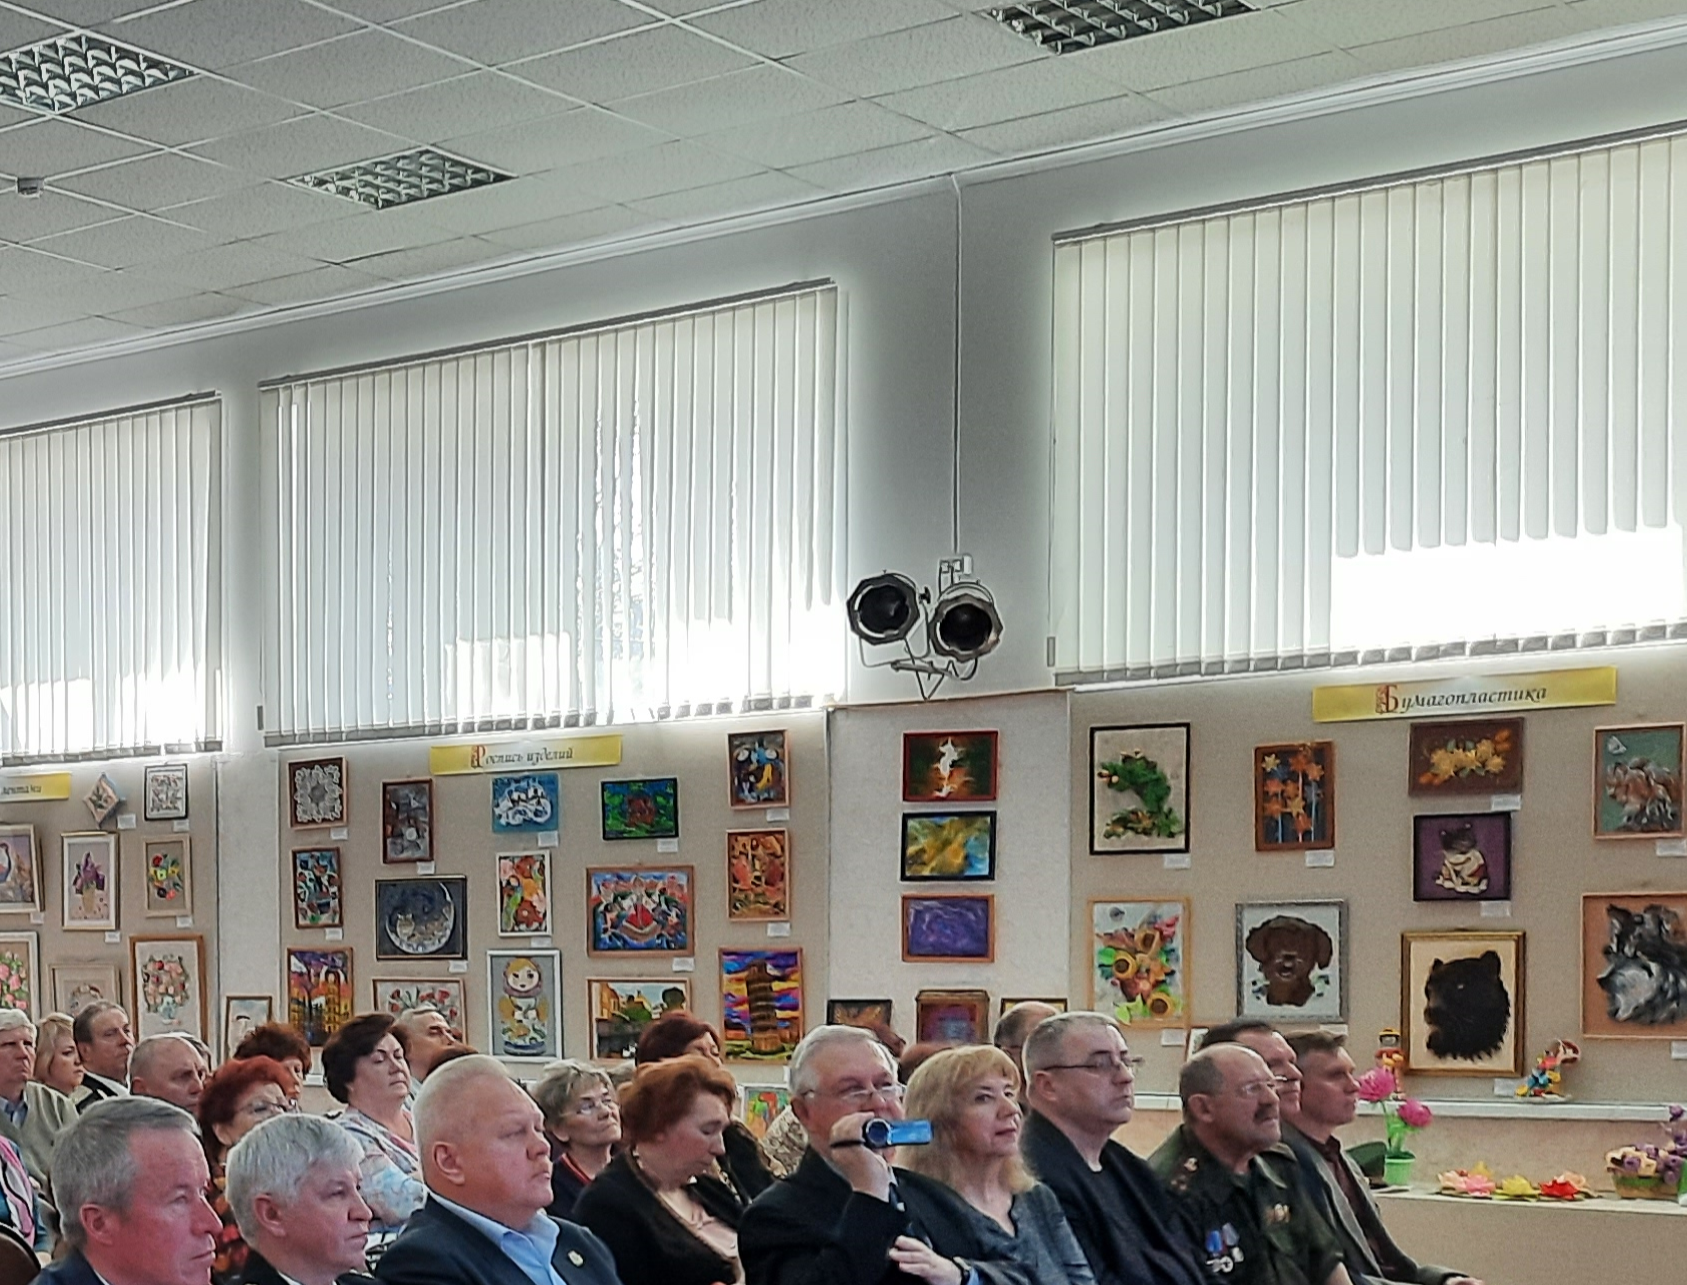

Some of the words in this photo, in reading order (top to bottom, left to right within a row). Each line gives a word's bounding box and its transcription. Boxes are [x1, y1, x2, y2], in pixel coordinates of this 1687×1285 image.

[1375, 684, 1547, 714] Бумагопластика
[470, 744, 523, 768] Роспись
[526, 747, 574, 766] изделий
